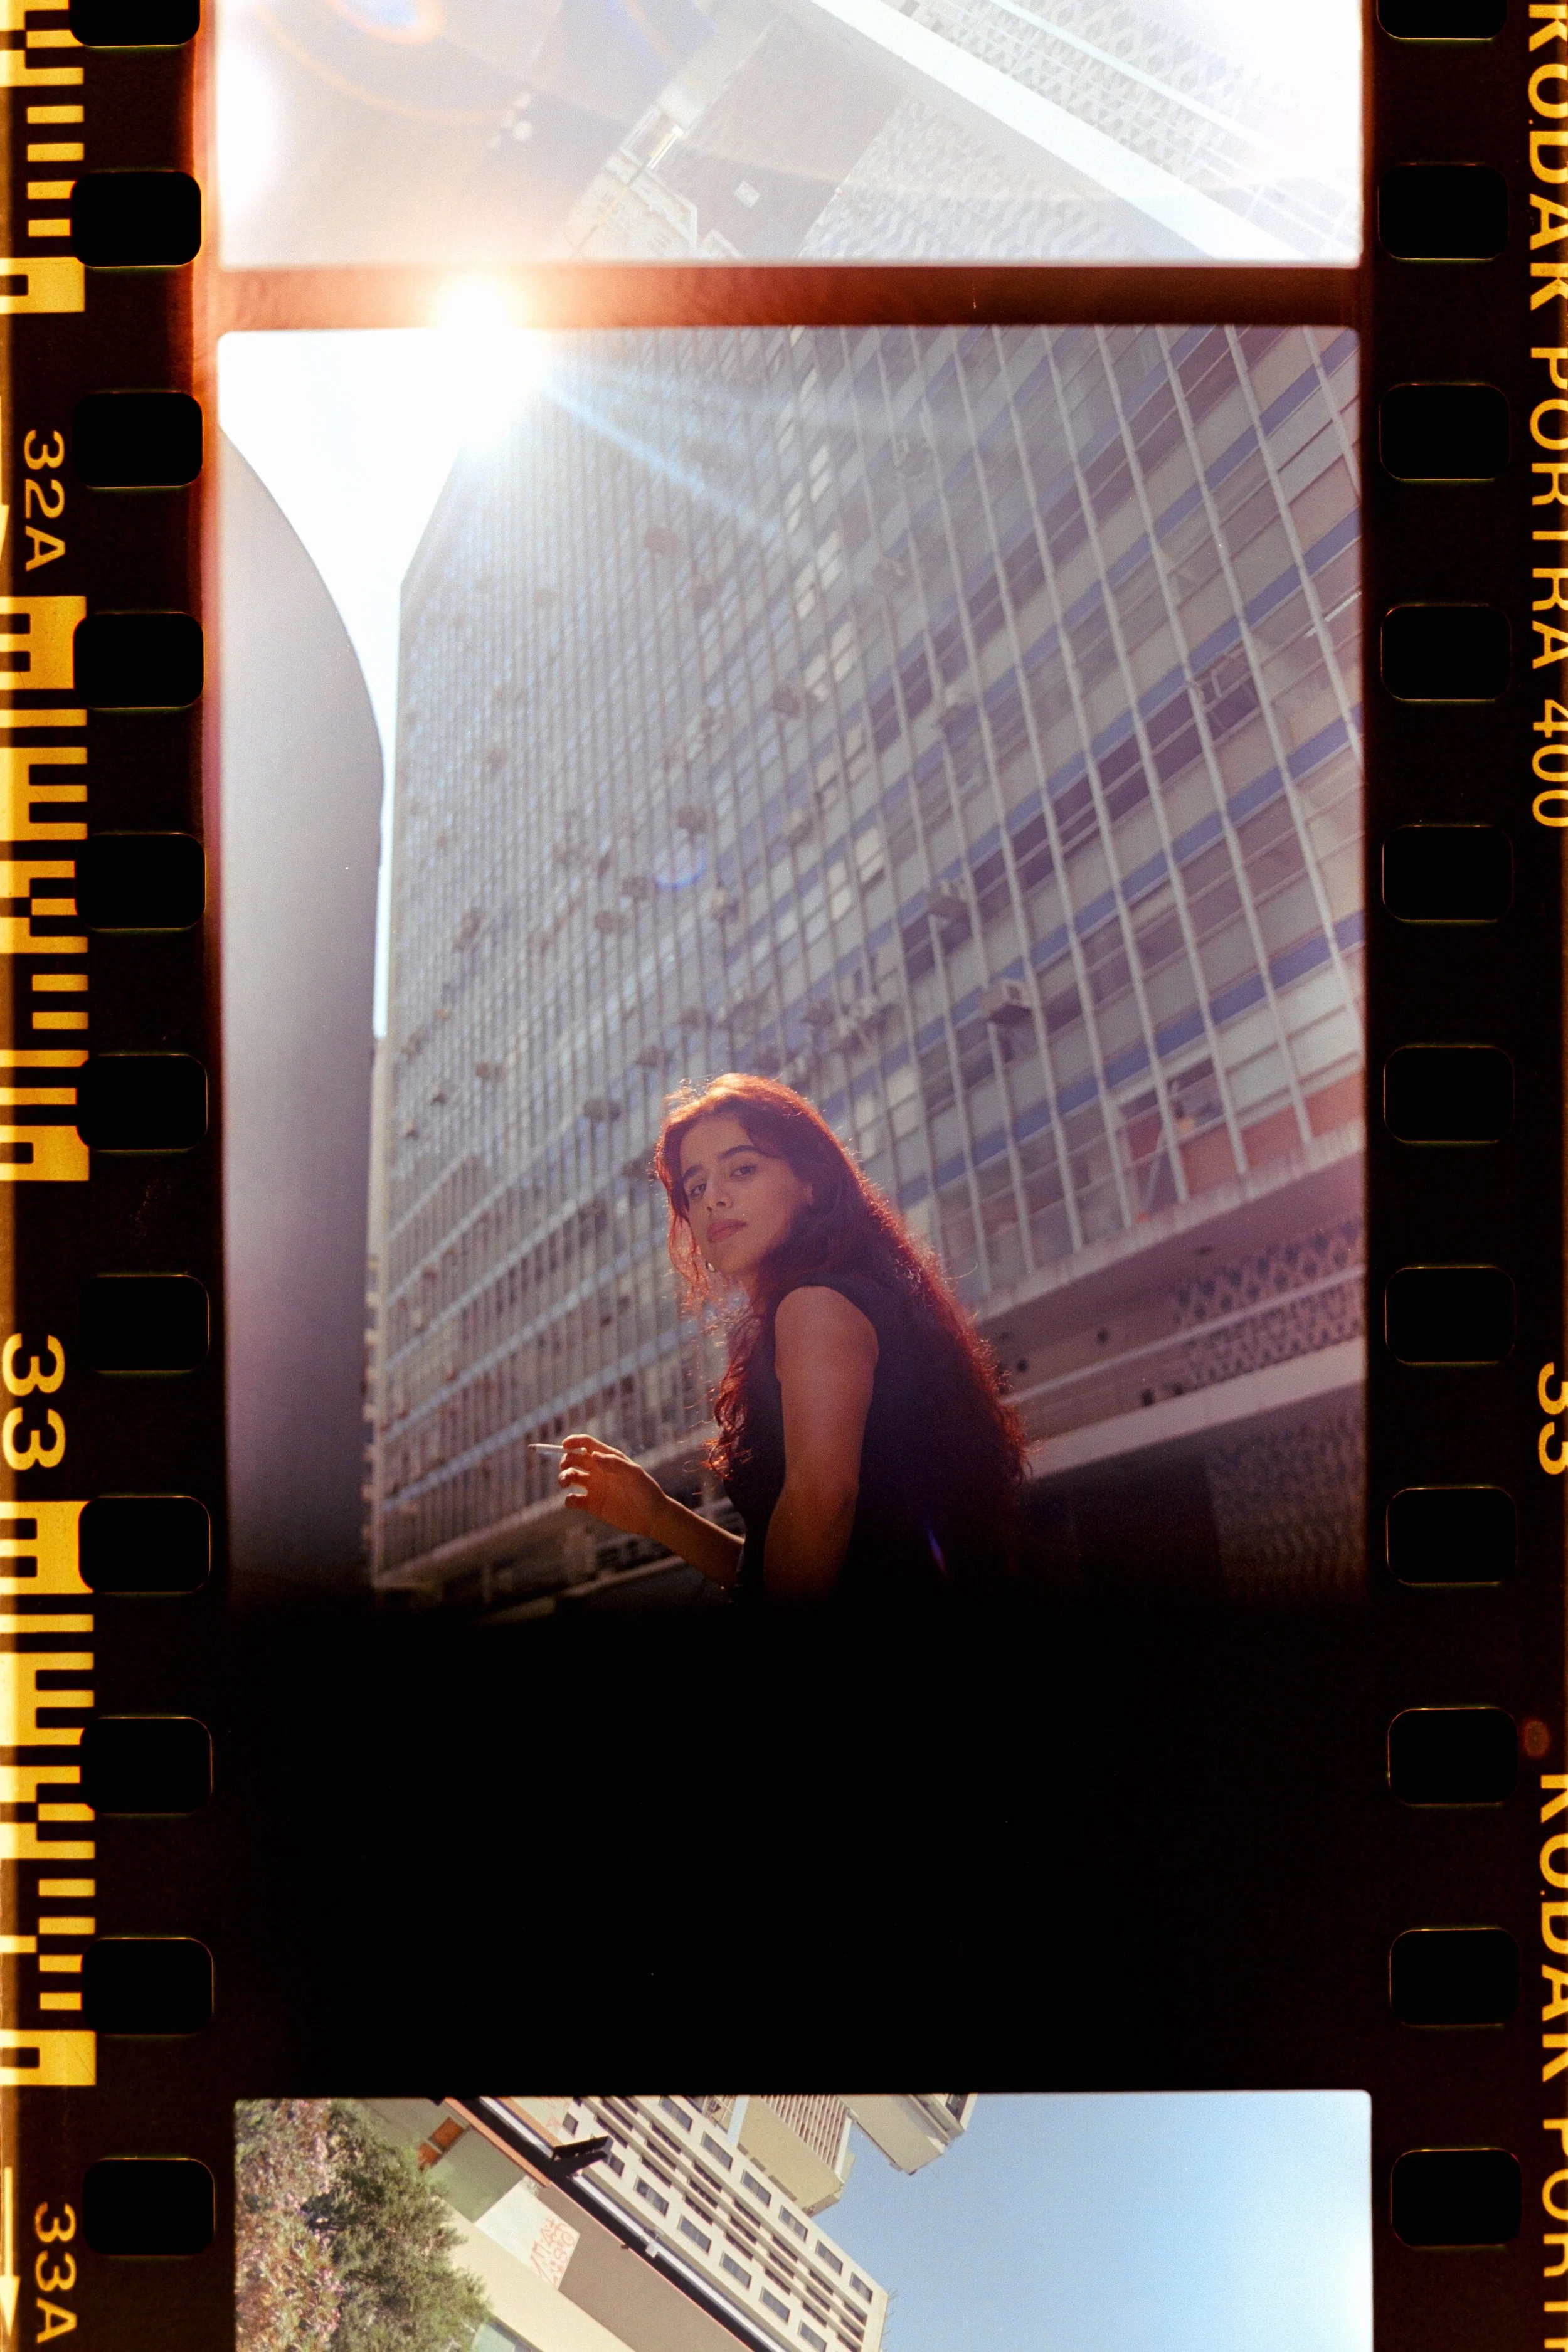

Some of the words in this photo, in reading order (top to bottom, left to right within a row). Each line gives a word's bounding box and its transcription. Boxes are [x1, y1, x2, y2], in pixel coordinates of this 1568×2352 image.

[1528, 4, 1568, 312] KODAK
[24, 430, 66, 572] 32A
[1530, 347, 1568, 669] PORTRA
[1532, 699, 1568, 828] 400
[2, 1333, 66, 1471] 33
[34, 2201, 77, 2344] 33A
